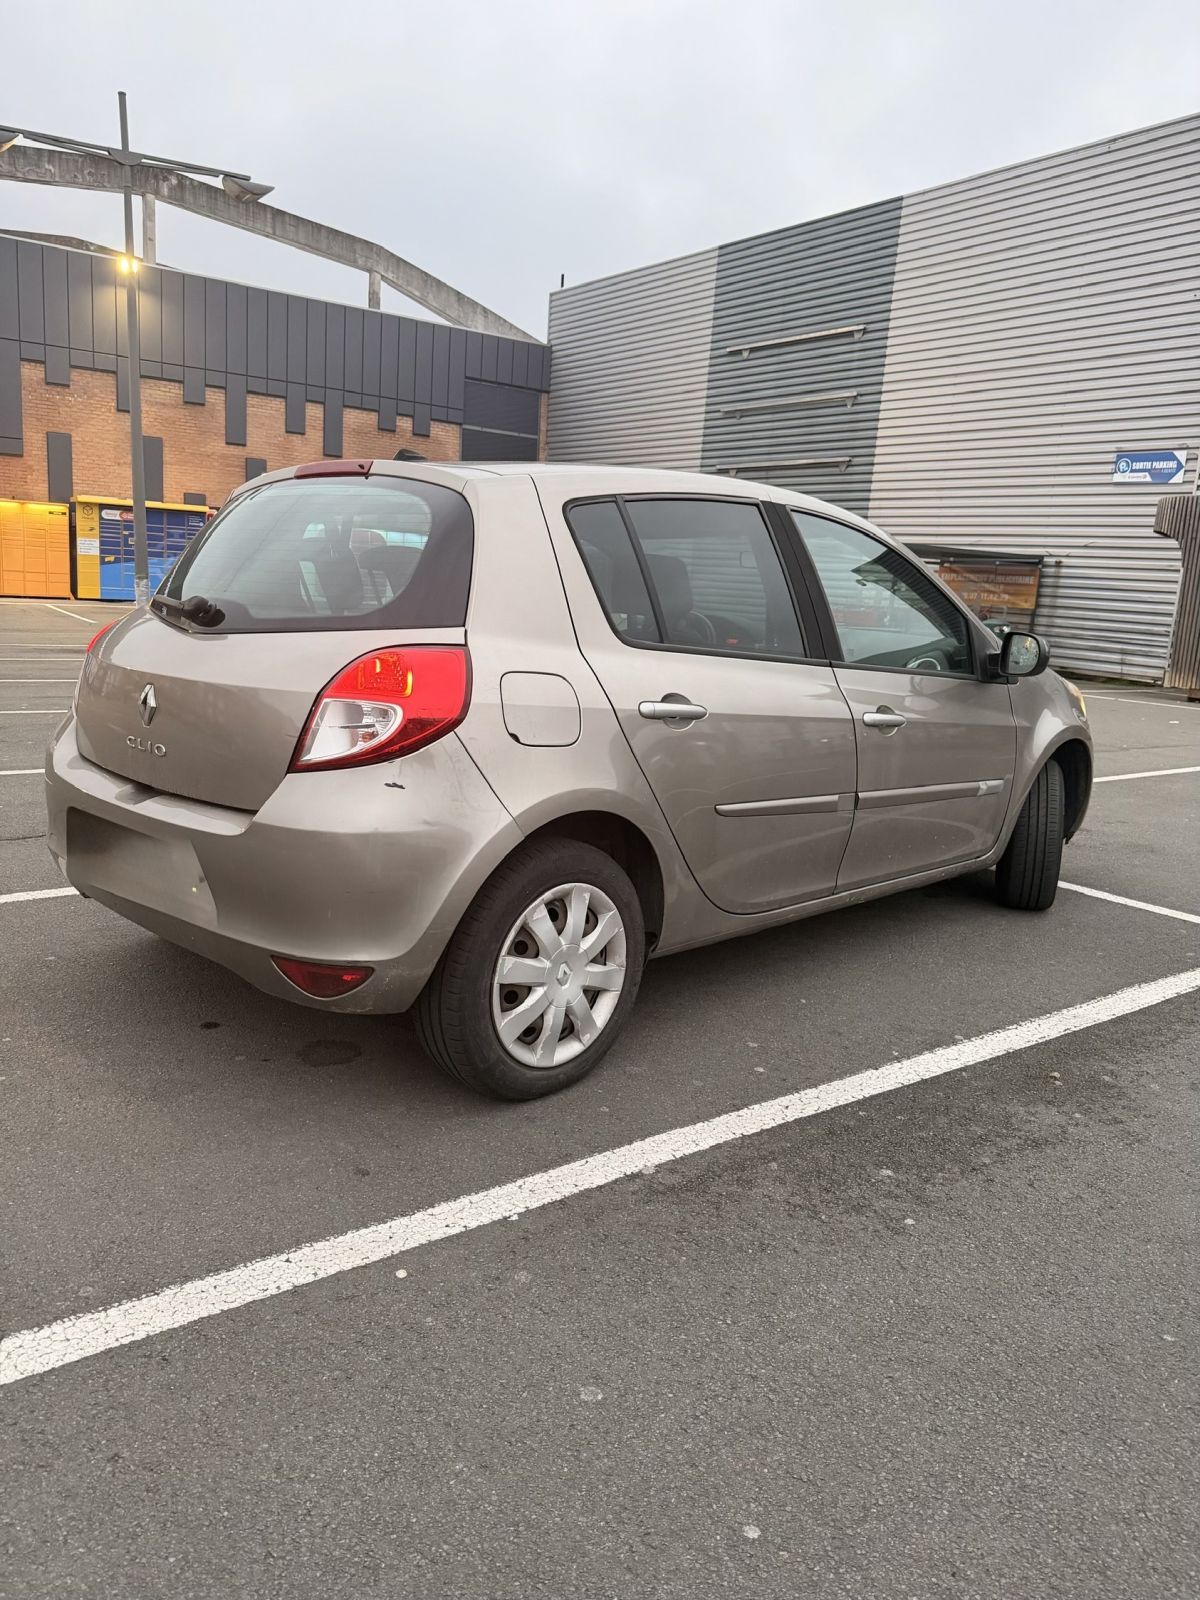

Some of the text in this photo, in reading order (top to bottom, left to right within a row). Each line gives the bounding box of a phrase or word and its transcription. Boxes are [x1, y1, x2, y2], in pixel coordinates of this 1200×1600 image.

[1132, 460, 1178, 470] SORTIE PARKING
[126, 735, 167, 757] CLIO
